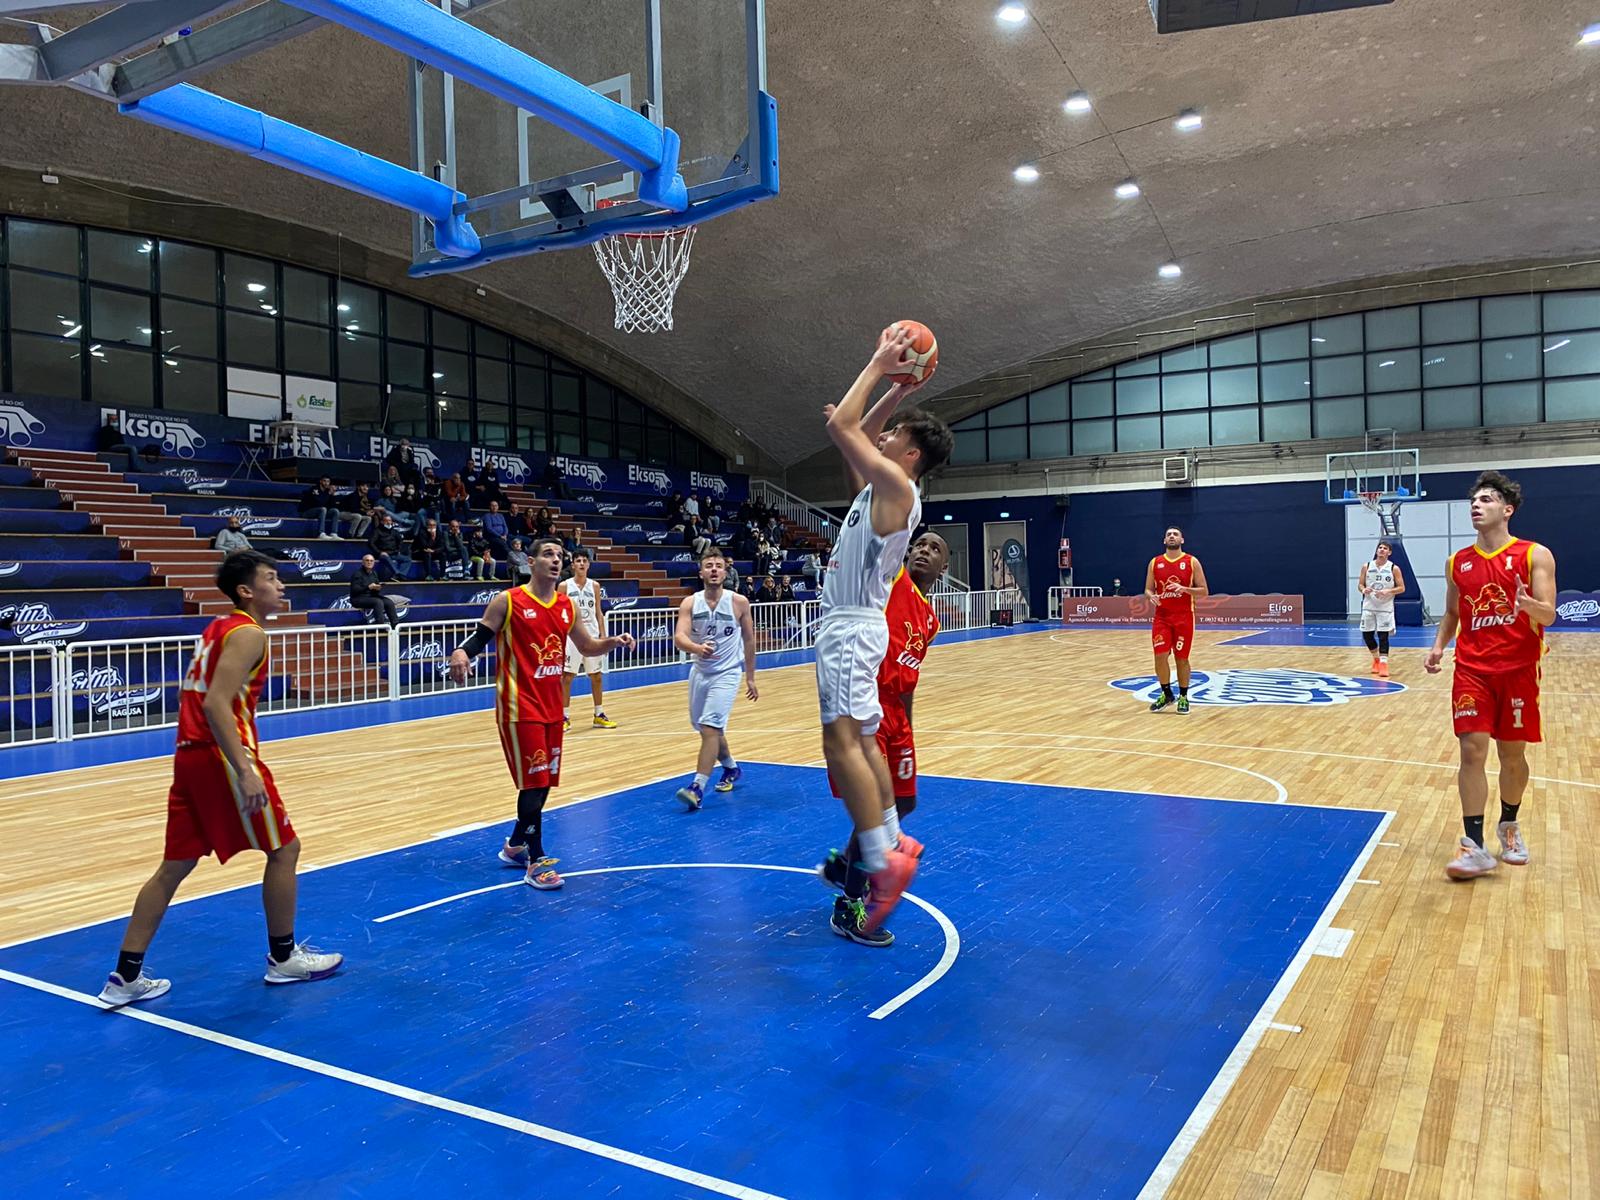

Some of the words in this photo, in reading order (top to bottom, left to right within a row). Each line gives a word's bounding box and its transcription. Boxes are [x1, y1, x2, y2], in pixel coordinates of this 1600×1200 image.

[556, 457, 588, 477] Ekso
[628, 464, 655, 483] Ekso
[690, 471, 714, 489] Ekso
[120, 540, 130, 549] VI
[1504, 556, 1514, 570] 1
[152, 566, 159, 575] V
[185, 592, 194, 600] IV
[1076, 604, 1098, 613] Eligo
[1269, 603, 1293, 613] Eligo
[561, 608, 570, 624] 4
[1471, 615, 1516, 631] LIONS
[1176, 641, 1184, 651] 8
[534, 664, 562, 679] LION
[112, 706, 143, 717] RAGUSA
[1512, 708, 1524, 728] 1
[897, 758, 913, 780] 0
